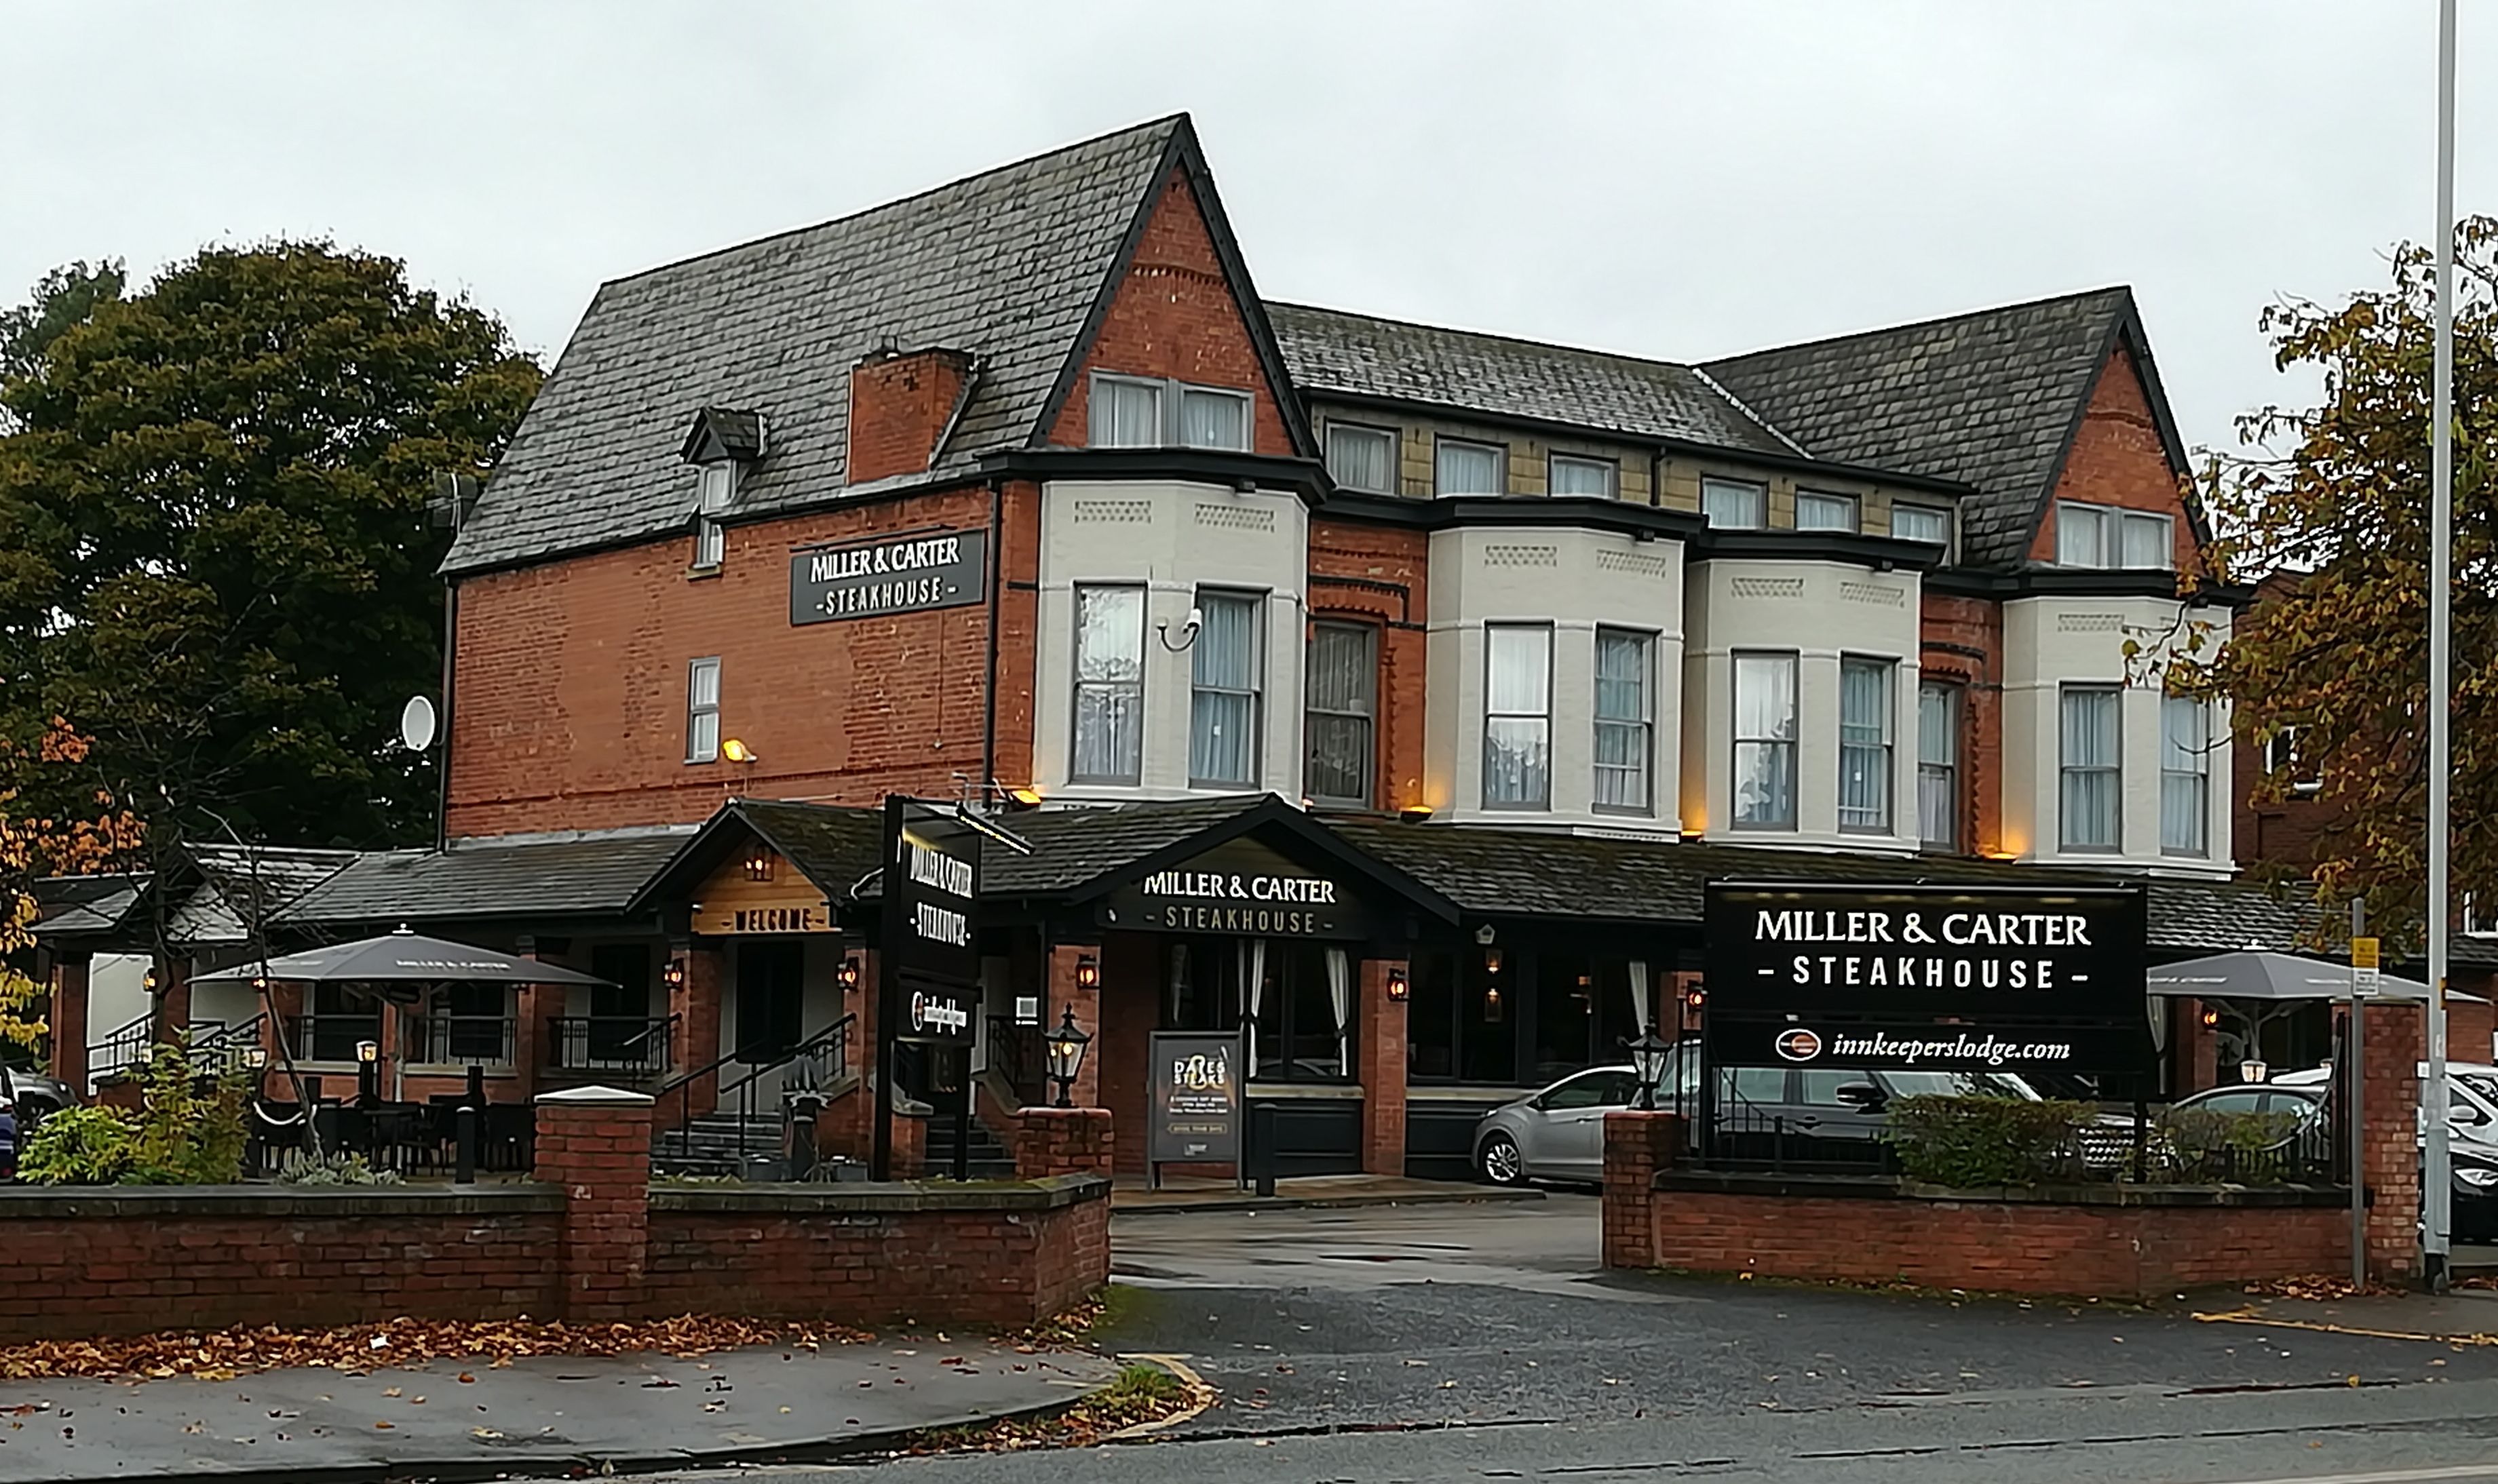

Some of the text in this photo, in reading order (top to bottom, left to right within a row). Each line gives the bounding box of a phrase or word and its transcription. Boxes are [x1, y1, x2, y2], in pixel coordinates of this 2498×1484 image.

[811, 537, 959, 583] MILLER & CARTER
[826, 577, 940, 614] STEAKHOUSE
[1144, 872, 1337, 903] MILLER & CARTER
[735, 909, 812, 931] WELCOME
[1166, 906, 1315, 933] STEAKHOUSE
[1755, 910, 2092, 945] MILLER & CARTER
[1793, 956, 2052, 989] STEAKHOUSE
[1832, 1032, 2070, 1066] innkeeperslodge.com
